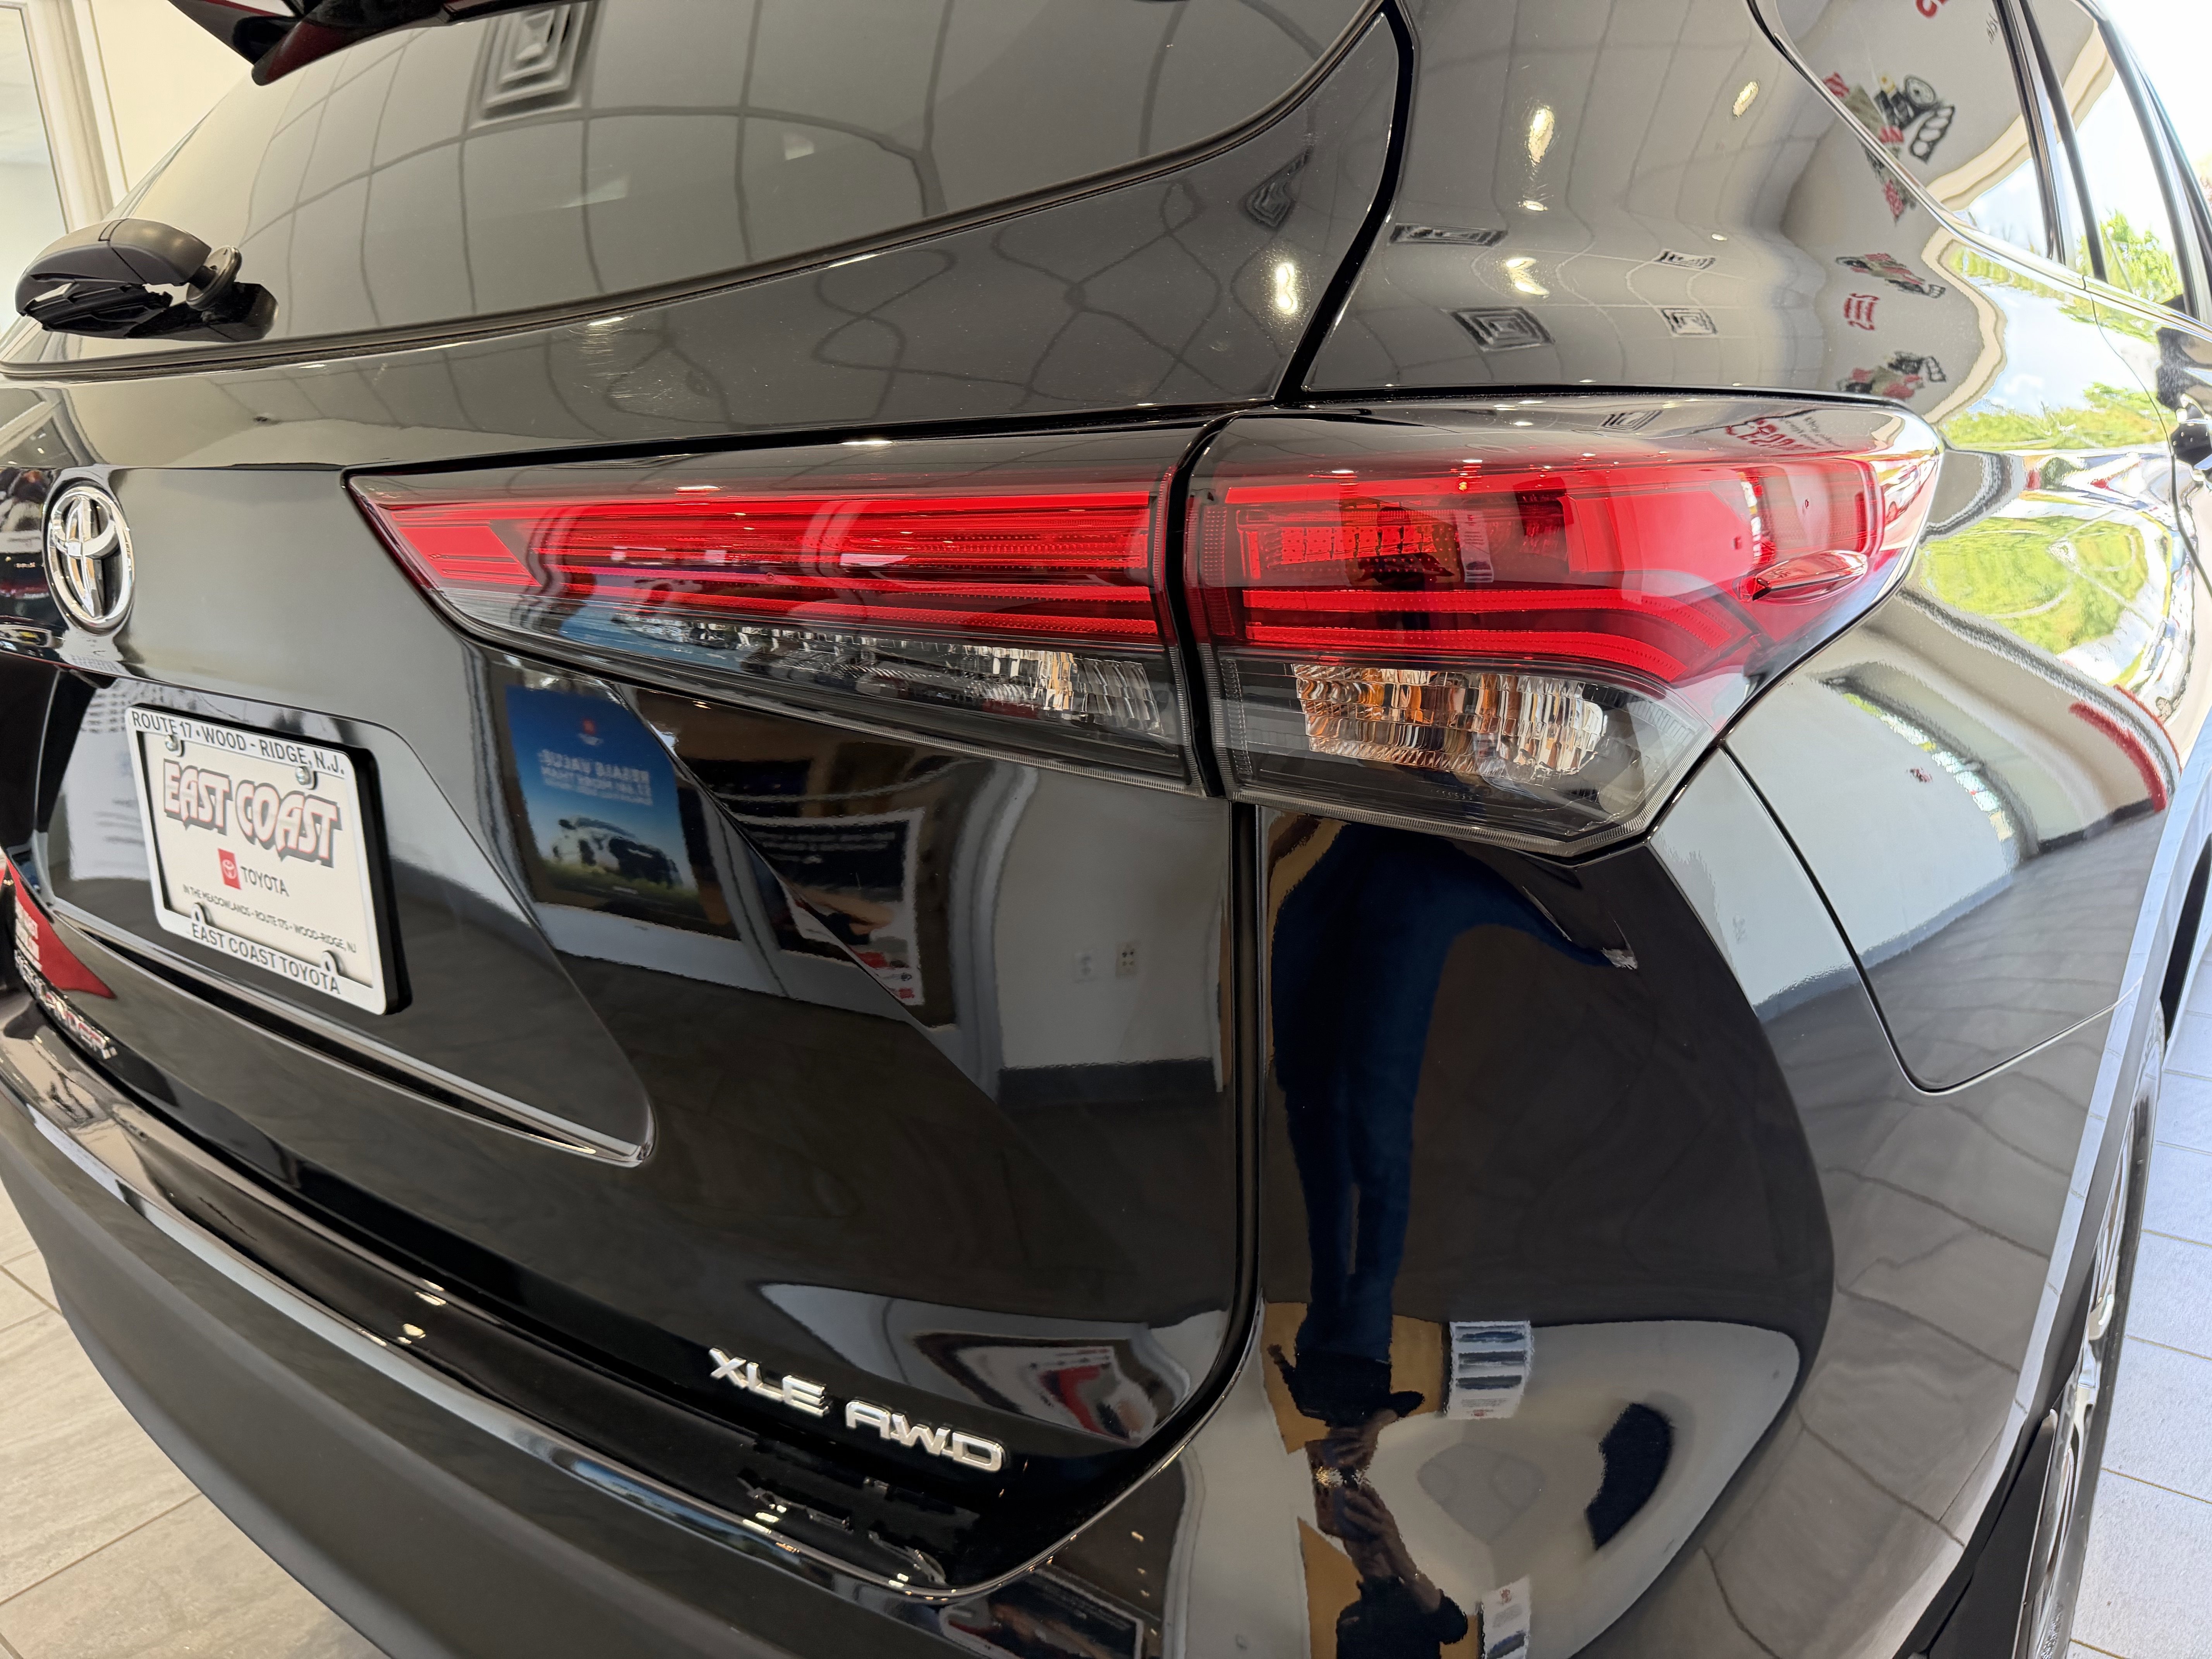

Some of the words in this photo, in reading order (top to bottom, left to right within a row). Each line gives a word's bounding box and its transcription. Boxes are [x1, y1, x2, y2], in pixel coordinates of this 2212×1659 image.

[132, 711, 177, 734] ROUTE
[180, 721, 191, 738] 17
[201, 725, 246, 750] WOOD
[259, 739, 312, 768] RIDGE,
[313, 750, 344, 774] N.J.
[163, 758, 233, 836] EAST
[235, 780, 342, 868] COAST
[240, 866, 290, 897] TOYOTA
[192, 922, 225, 949] EAST
[228, 938, 277, 968] COAST
[278, 956, 340, 994] TOYOTA
[709, 1347, 830, 1417] XLE
[845, 1398, 1007, 1472] AWD
